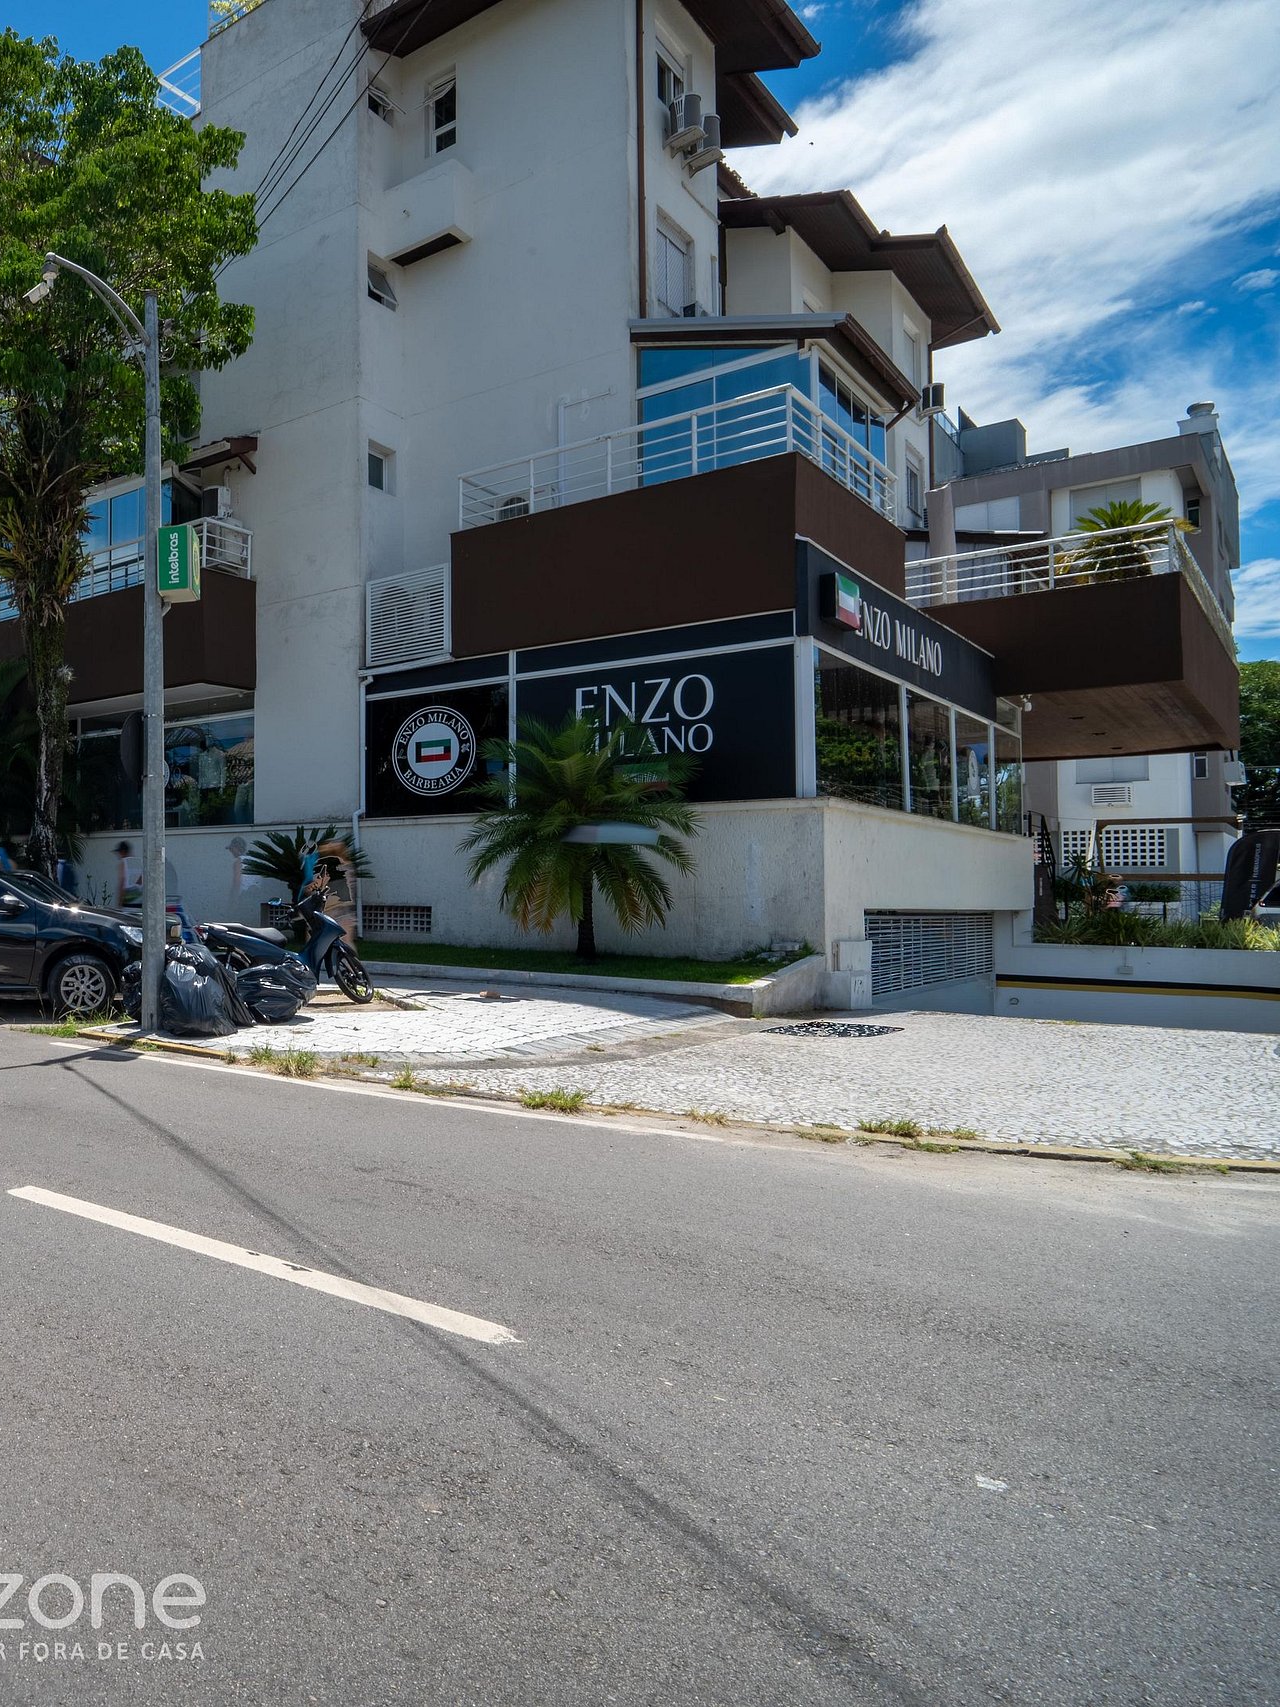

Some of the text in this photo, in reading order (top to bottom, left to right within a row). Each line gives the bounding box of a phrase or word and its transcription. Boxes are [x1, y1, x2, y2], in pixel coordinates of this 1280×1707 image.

[168, 532, 180, 584] intelbras
[894, 619, 943, 677] MILANO
[575, 673, 715, 727] ENZO
[399, 712, 469, 745] ENZO MILANO
[403, 766, 464, 789] BARBEARIA
